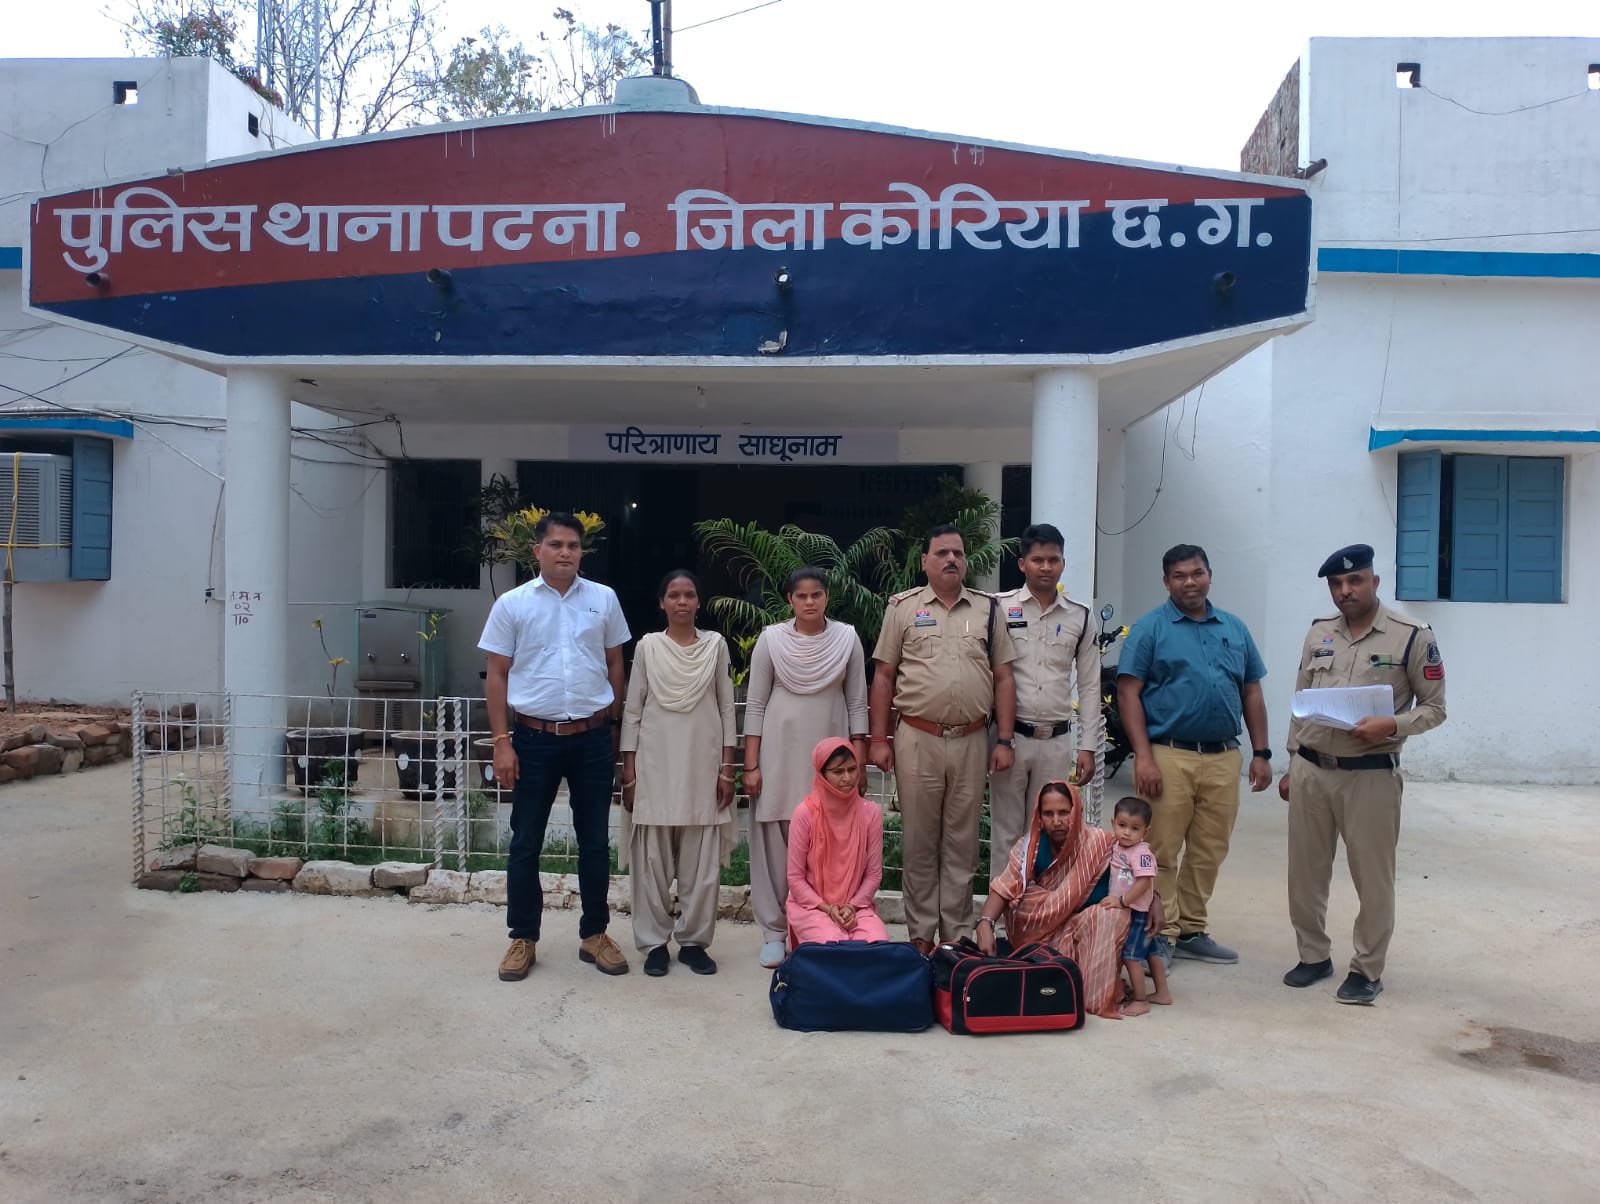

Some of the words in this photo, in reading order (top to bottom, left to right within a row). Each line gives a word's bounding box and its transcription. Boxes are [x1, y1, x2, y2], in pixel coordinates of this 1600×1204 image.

[53, 187, 258, 273] पुलिस
[262, 201, 429, 253] थाना
[667, 188, 834, 252] जिला
[840, 182, 1091, 250] कोरिया
[605, 426, 722, 455] परित्राणाय
[738, 434, 843, 462] साधूनाम
